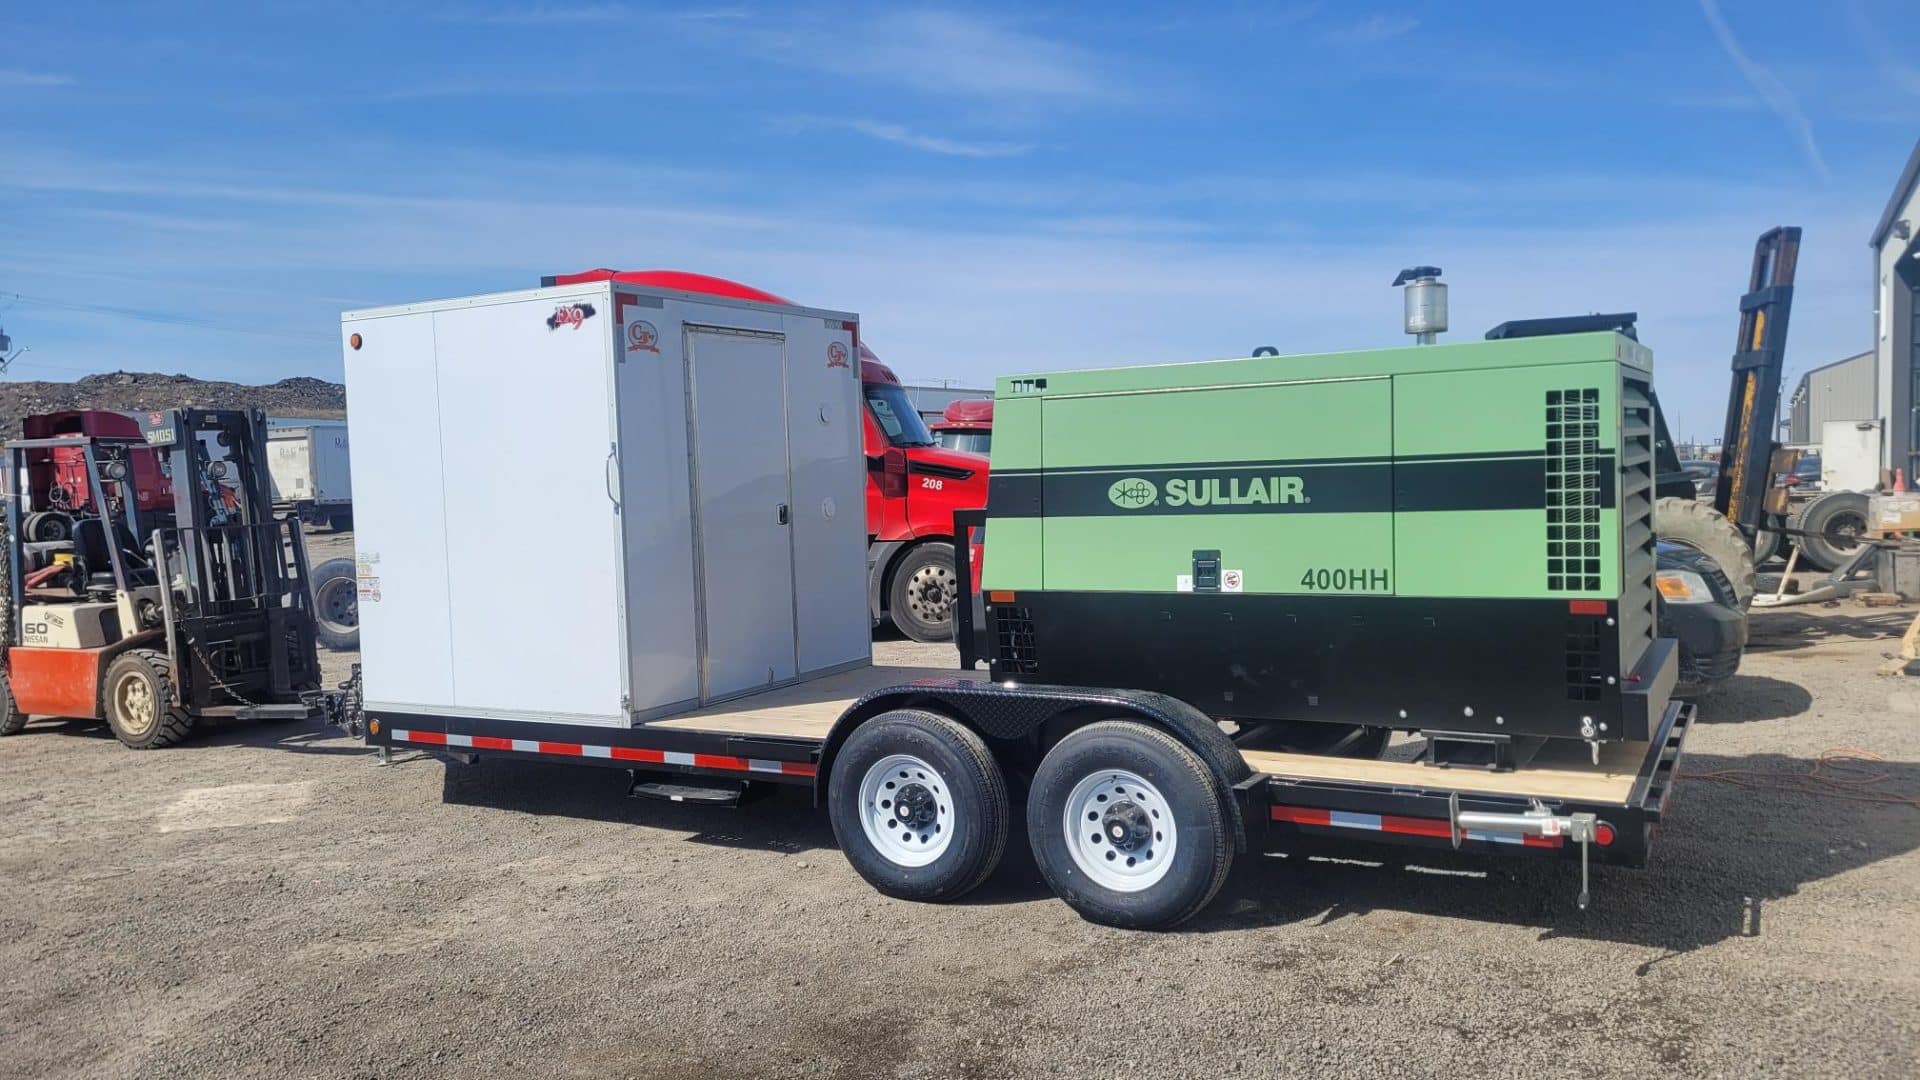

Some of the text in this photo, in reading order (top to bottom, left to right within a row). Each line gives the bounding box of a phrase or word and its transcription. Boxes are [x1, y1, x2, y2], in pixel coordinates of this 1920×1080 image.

[921, 477, 943, 490] 208
[1165, 476, 1304, 507] SULLAIR
[1300, 568, 1389, 591] 400HH
[24, 622, 48, 635] 60
[24, 634, 49, 644] NISSAN
